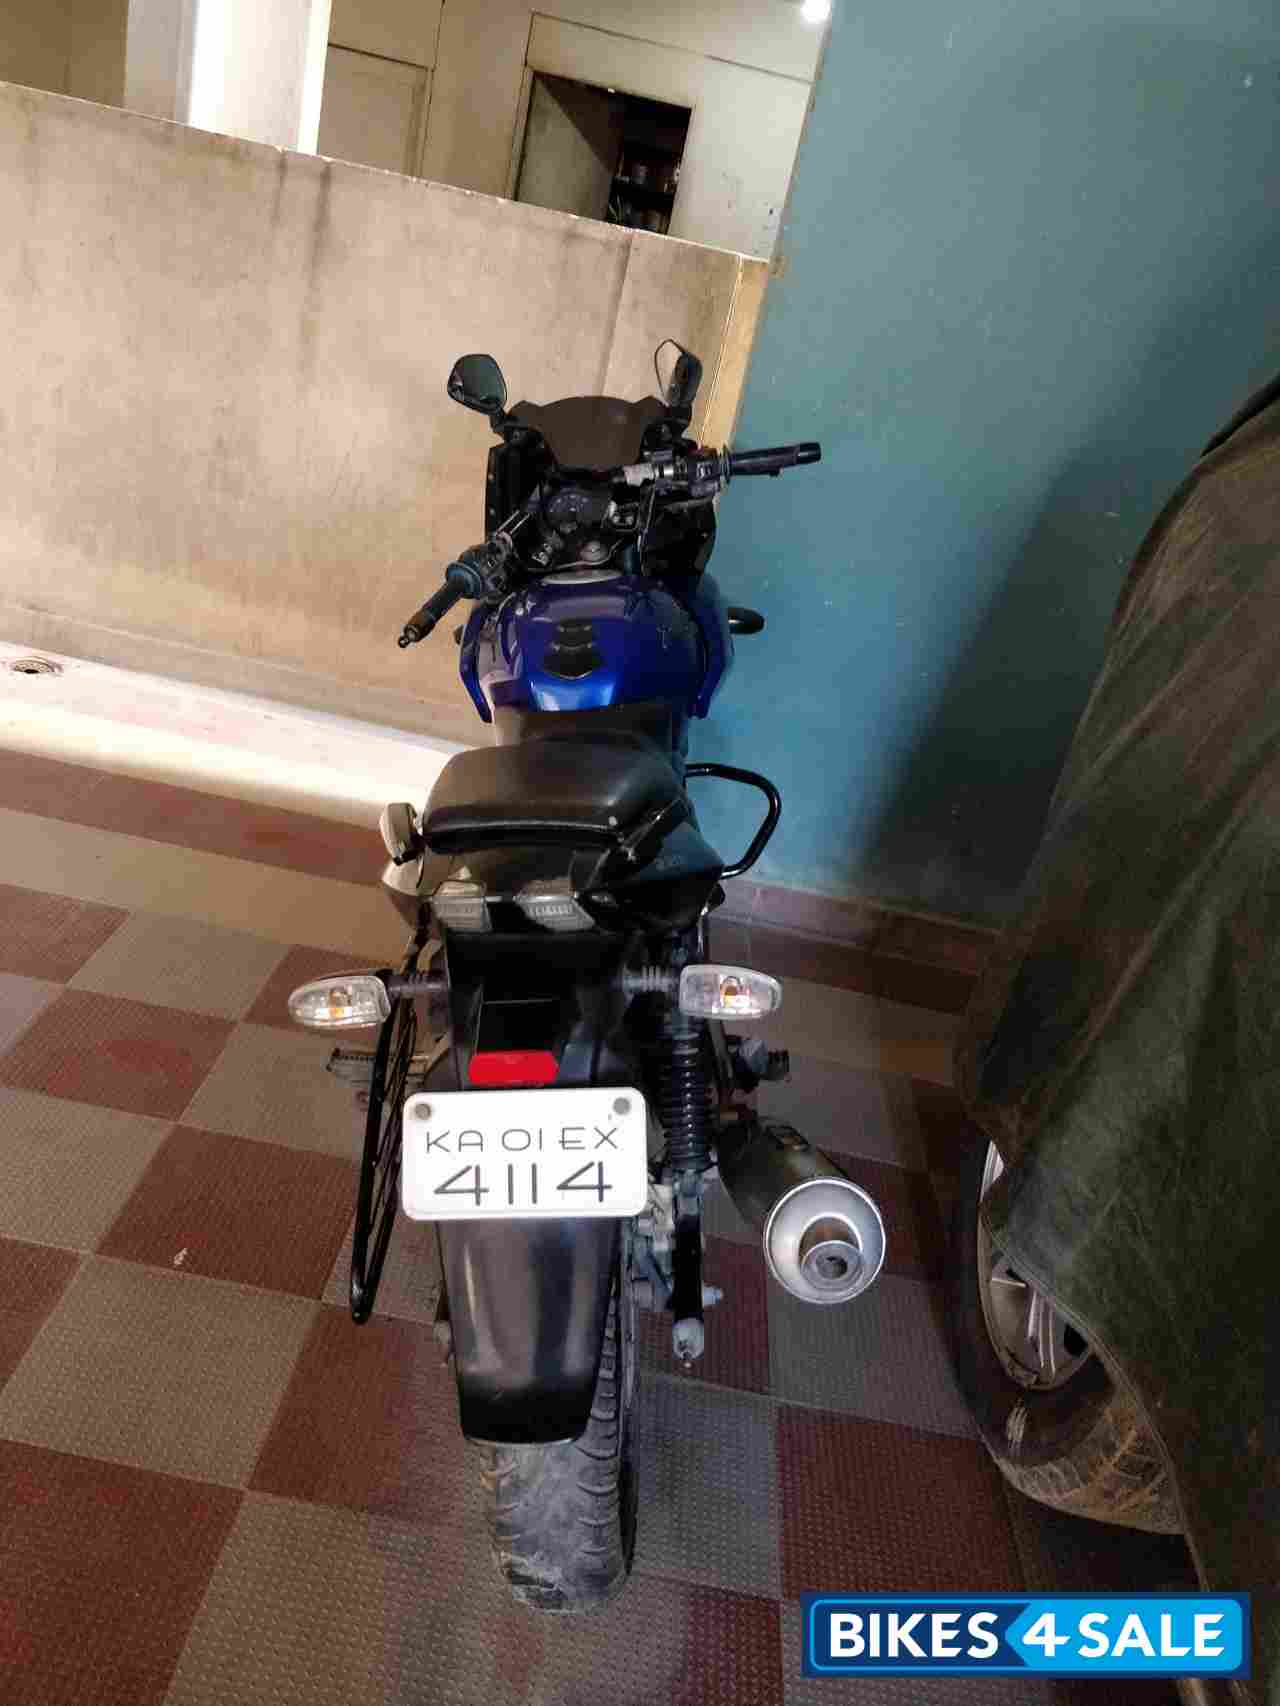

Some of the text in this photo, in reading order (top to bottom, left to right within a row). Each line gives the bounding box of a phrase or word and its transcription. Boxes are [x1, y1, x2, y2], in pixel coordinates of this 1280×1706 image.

[426, 1129, 484, 1154] KA
[558, 1126, 618, 1150] EX
[434, 1160, 613, 1206] 4114
